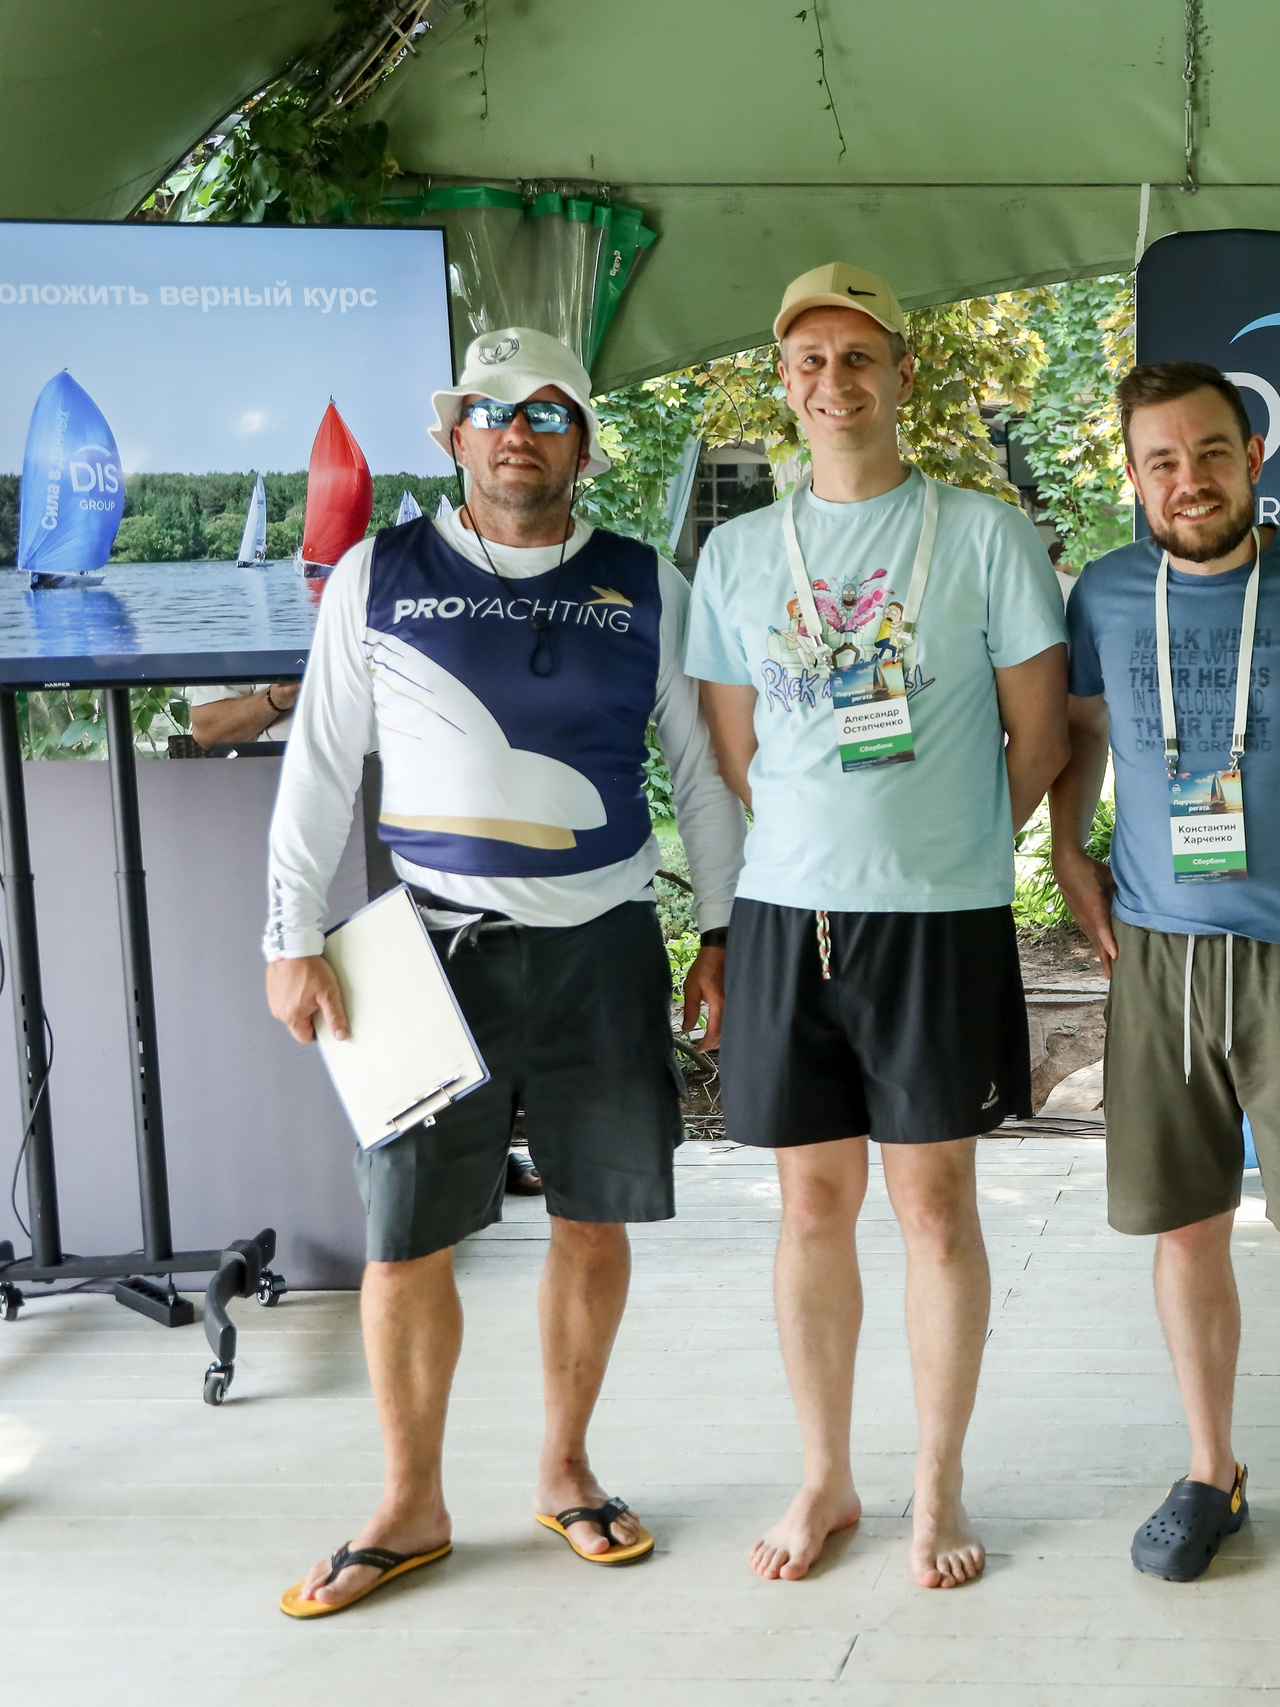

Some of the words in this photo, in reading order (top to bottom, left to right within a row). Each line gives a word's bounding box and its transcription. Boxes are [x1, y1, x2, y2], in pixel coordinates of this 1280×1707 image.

[160, 280, 292, 312] верный
[304, 285, 378, 314] курс
[51, 409, 70, 469] данных
[49, 470, 61, 481] в
[69, 461, 119, 494] DIS
[41, 484, 60, 530] Сила
[79, 499, 116, 512] GROUP
[393, 596, 632, 633] PROYACHTING
[1134, 628, 1201, 649] WLK
[1209, 628, 1272, 649] WIH
[1204, 649, 1240, 665] WIT
[1177, 688, 1232, 715] CLOUDS
[844, 709, 900, 724] Александр
[843, 718, 904, 735] Остапченко
[859, 742, 894, 753] Сбербанк
[1178, 824, 1237, 834] Константин
[1183, 834, 1233, 845] Харченко
[1192, 857, 1227, 866] Сбербанк
